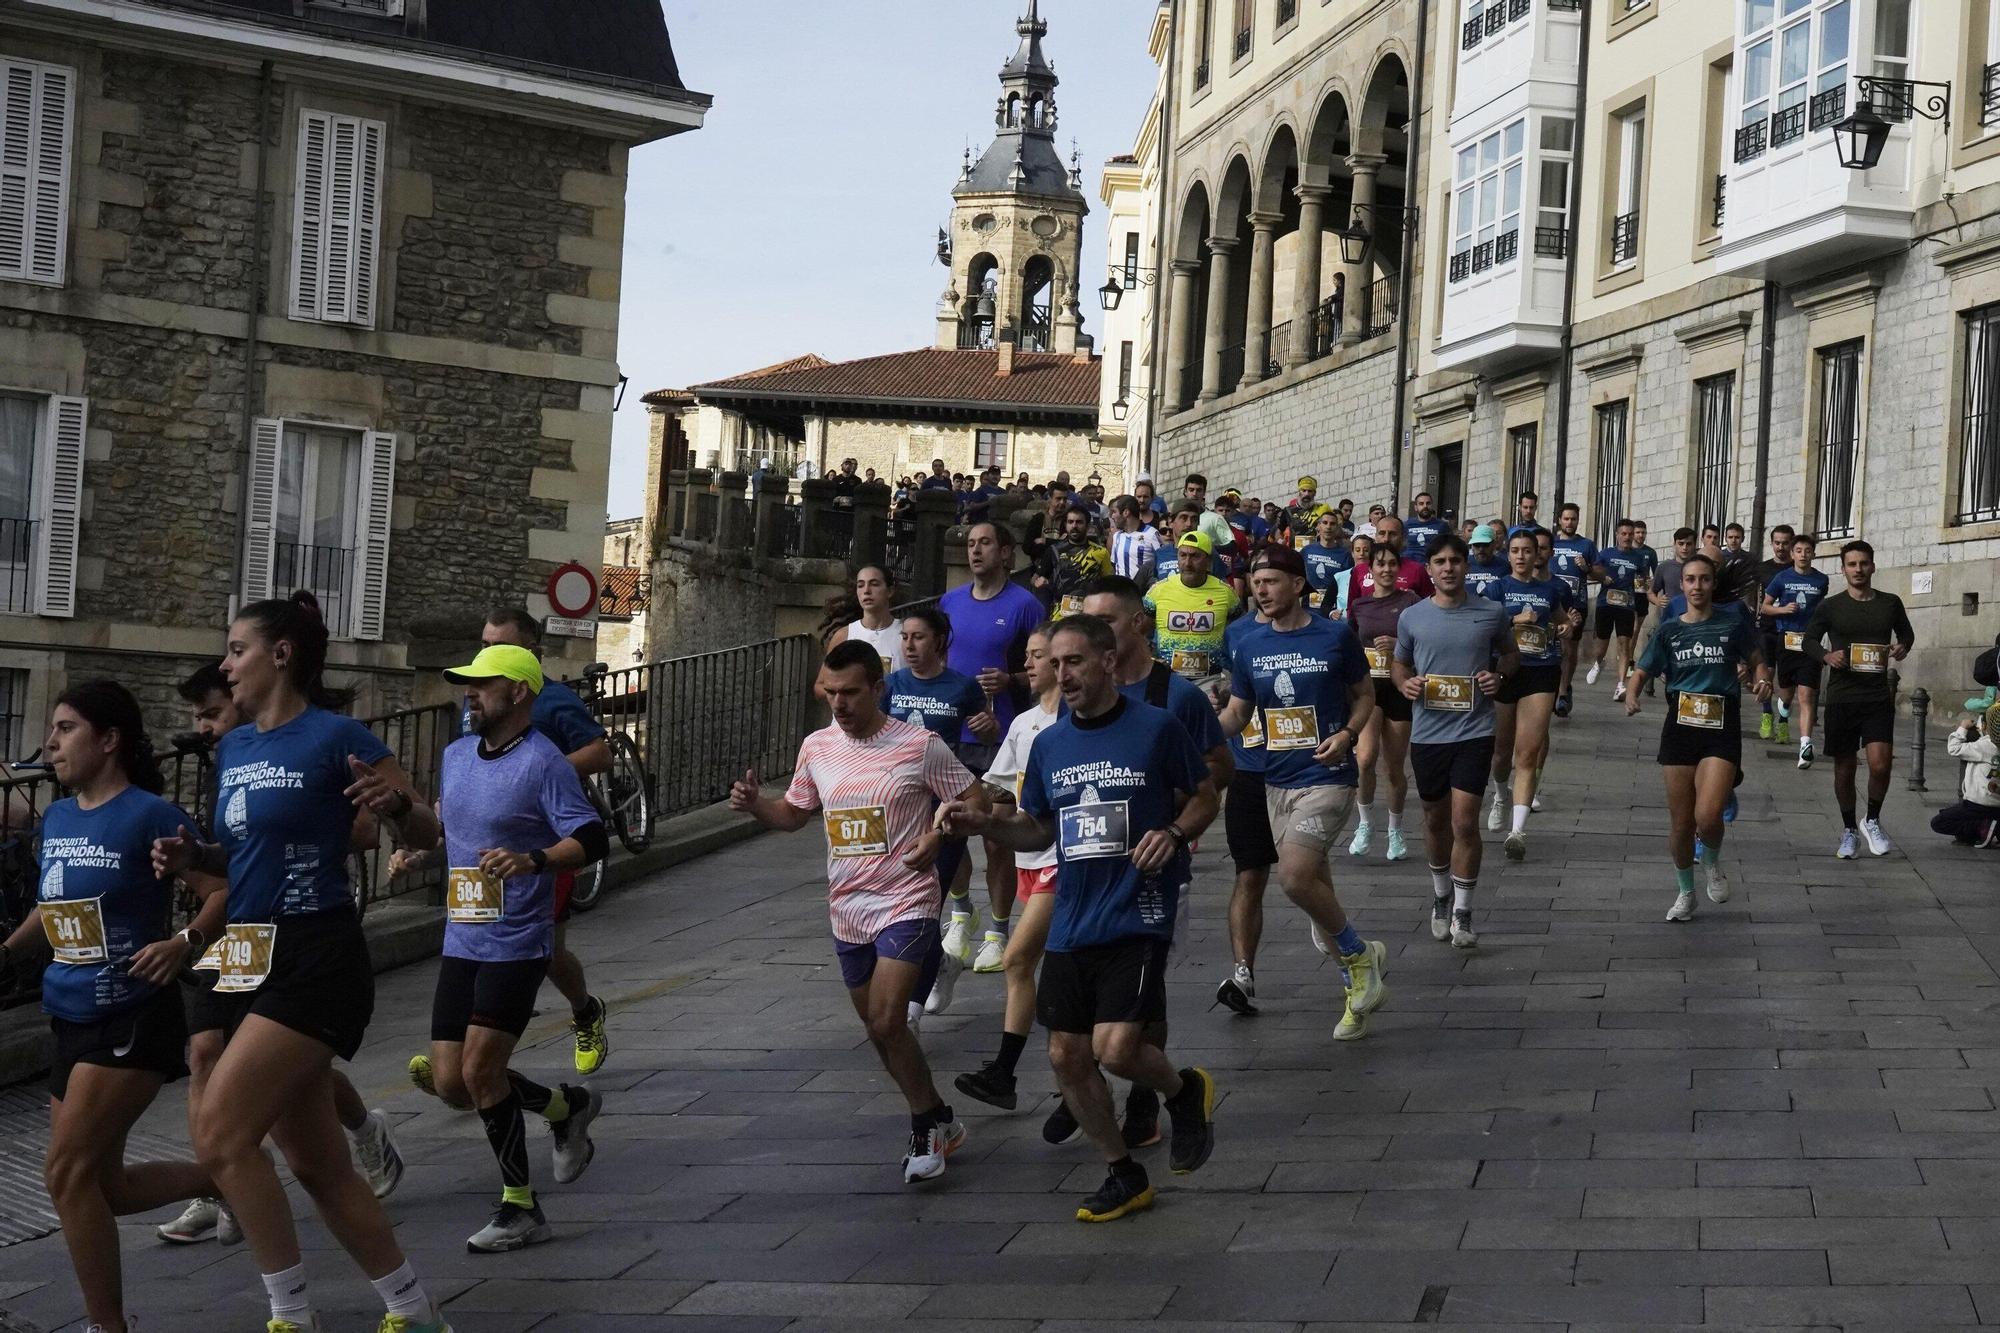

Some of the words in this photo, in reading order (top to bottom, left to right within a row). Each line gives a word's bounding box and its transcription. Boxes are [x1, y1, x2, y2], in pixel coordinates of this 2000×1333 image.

[1182, 657, 1200, 668] 224
[1261, 653, 1302, 662] CONQUISTA
[1263, 657, 1317, 671] ALMENDRA
[1290, 665, 1328, 674] KONKISTA
[1438, 684, 1460, 698] 213
[897, 694, 937, 703] CONQUISTA
[897, 700, 950, 710] ALMENDRA
[924, 709, 958, 717] KONKISTA
[1276, 717, 1303, 734] 599
[227, 760, 269, 776] CONQUISTA
[1052, 771, 1061, 780] LA
[1061, 761, 1112, 776] CONQUISTA
[223, 766, 286, 788] ALMENDRA
[1063, 767, 1133, 787] ALMENDRA
[1098, 778, 1146, 788] KONKISTA
[248, 778, 304, 791] KONKISTA
[841, 819, 867, 840] 677
[1076, 816, 1107, 838] 754
[47, 837, 88, 846] CONQUISTA
[45, 845, 106, 859] ALMENDRA
[105, 851, 121, 859] REN
[67, 858, 120, 869] KONKISTA
[457, 881, 484, 902] 584
[53, 916, 82, 940] 341
[226, 941, 252, 966] 249
